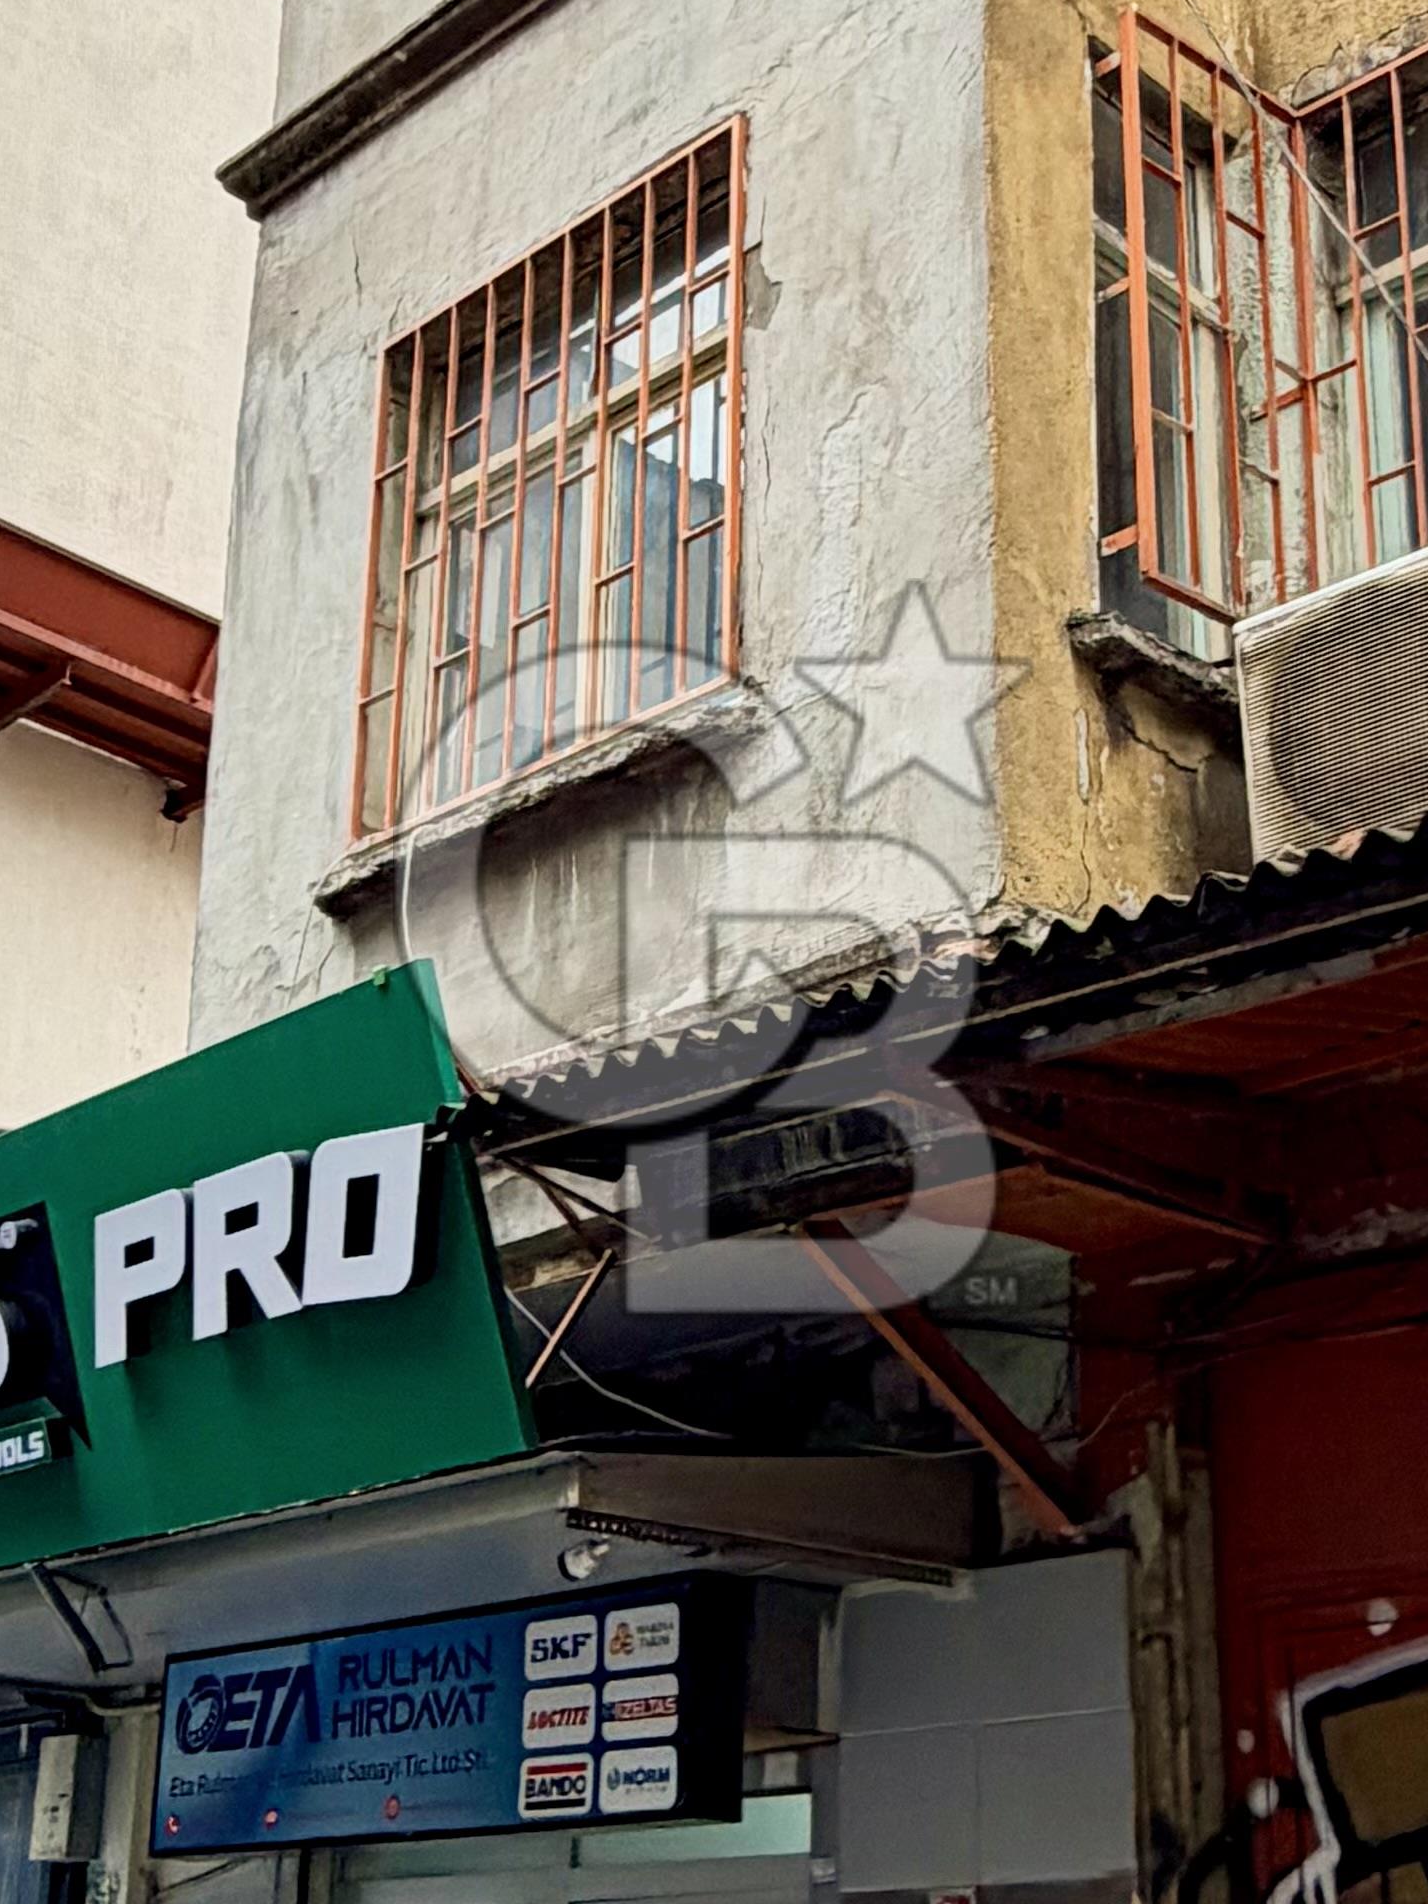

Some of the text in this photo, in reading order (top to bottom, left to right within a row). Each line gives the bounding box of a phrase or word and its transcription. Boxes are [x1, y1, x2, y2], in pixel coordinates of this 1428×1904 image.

[95, 1122, 424, 1369] PRO
[338, 1634, 493, 1693] RULMAN
[530, 1632, 593, 1663] SKF
[331, 1683, 496, 1740] HIRDAVAT
[527, 1705, 591, 1730] LOCTITE
[525, 1774, 587, 1799] BANDO
